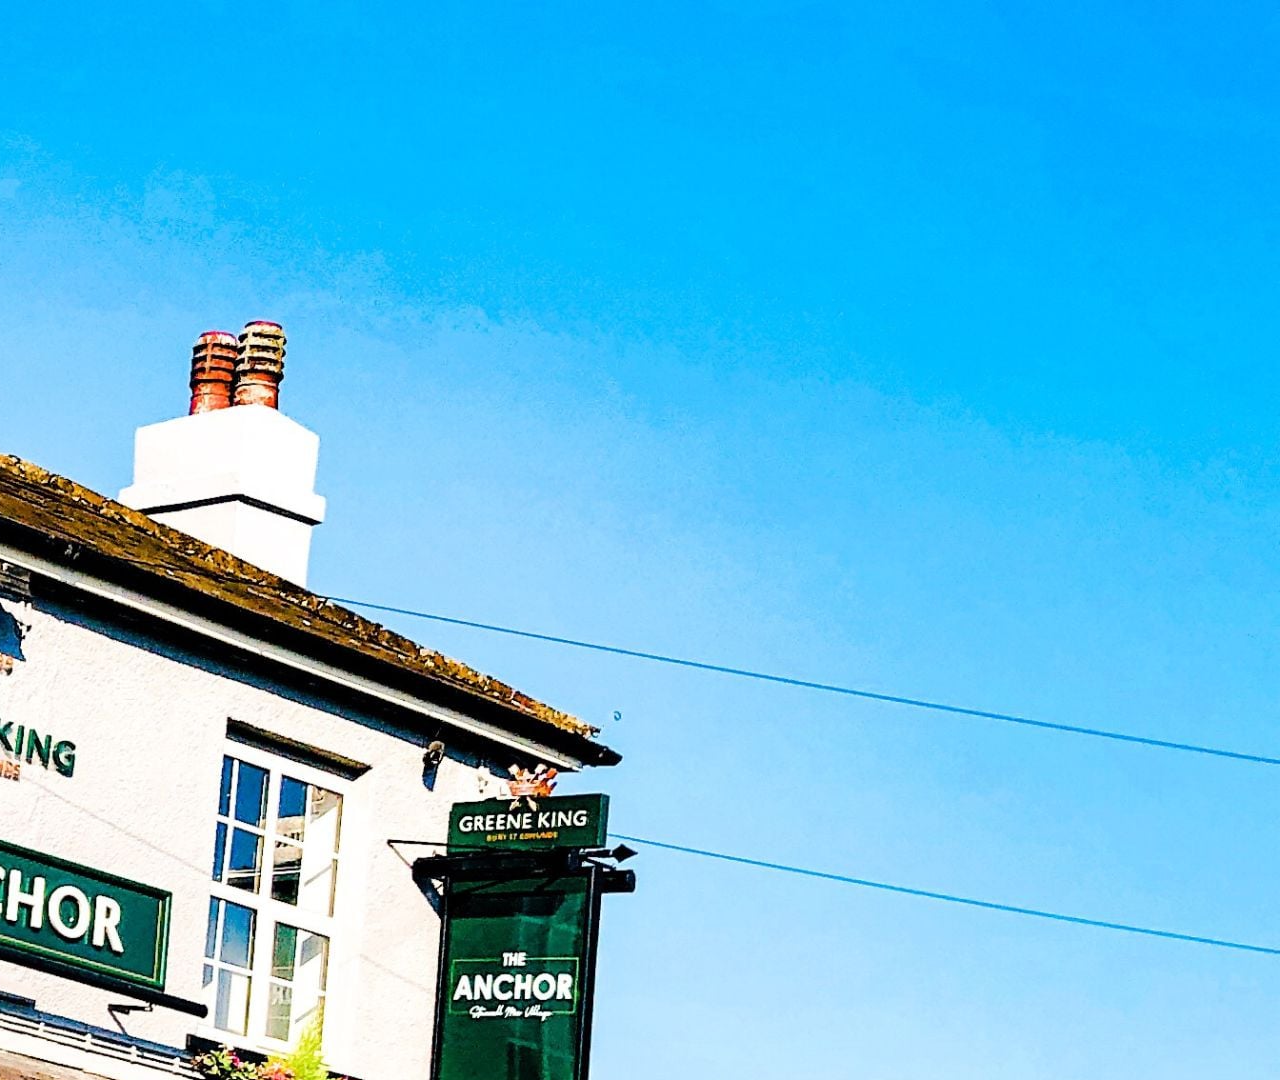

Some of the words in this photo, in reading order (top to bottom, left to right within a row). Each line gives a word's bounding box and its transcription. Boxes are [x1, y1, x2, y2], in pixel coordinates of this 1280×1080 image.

[458, 813, 532, 832] GREENE
[537, 810, 588, 828] KING
[502, 952, 527, 966] THE
[453, 973, 573, 1000] ANCHOR
